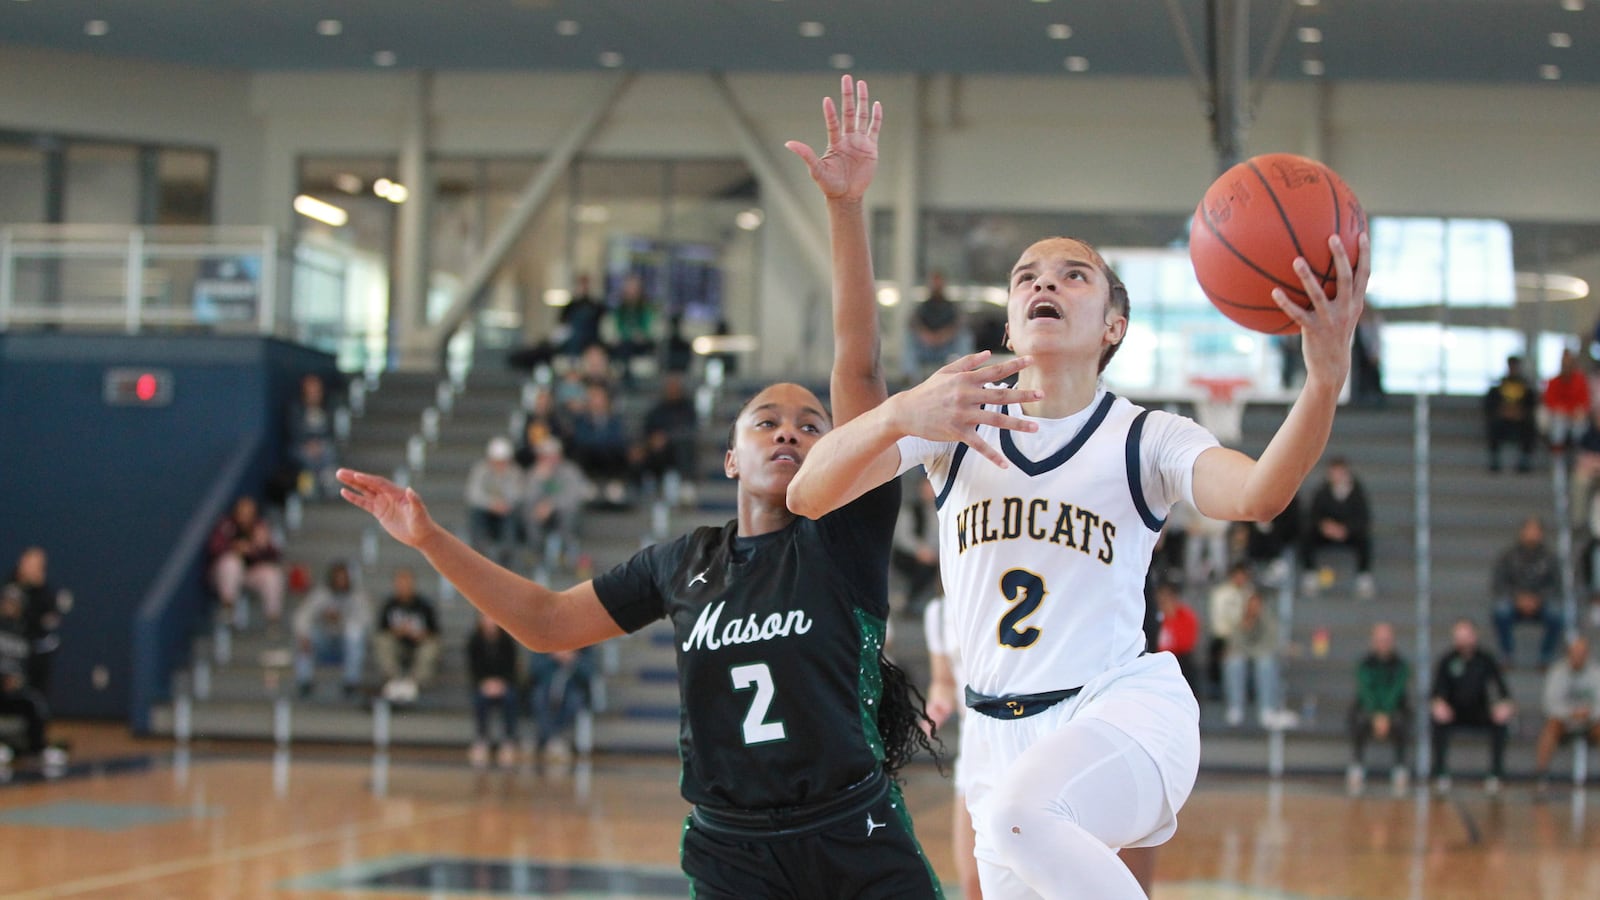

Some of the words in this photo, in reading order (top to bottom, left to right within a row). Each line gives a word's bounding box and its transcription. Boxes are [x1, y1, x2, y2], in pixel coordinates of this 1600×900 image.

[957, 497, 1117, 566] WILDCATS
[682, 600, 813, 652] Mason
[997, 567, 1049, 651] 2
[728, 661, 789, 748] 2
